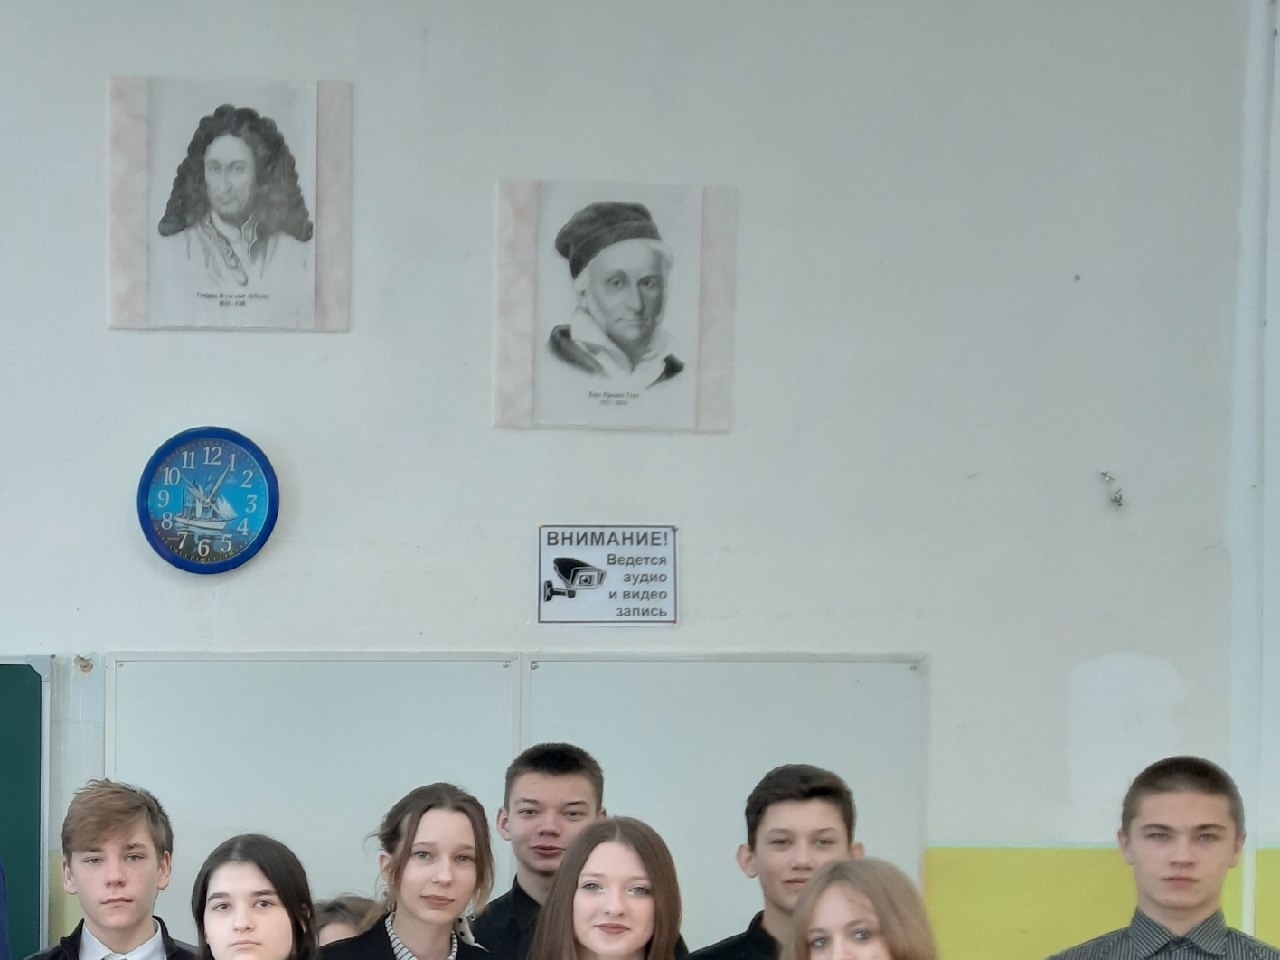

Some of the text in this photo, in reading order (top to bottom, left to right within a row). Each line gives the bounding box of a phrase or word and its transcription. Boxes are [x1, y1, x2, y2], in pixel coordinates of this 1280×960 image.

[181, 450, 195, 469] 11
[202, 446, 222, 466] 12
[228, 453, 236, 472] 1
[163, 467, 180, 486] 10
[241, 470, 253, 487] 2
[159, 490, 169, 507] 9
[245, 494, 257, 514] 3
[162, 513, 172, 529] 8
[237, 517, 249, 536] 4
[177, 531, 188, 550] 7
[197, 538, 210, 557] 6
[220, 533, 233, 552] 5
[546, 530, 669, 547] ВНИМАНИЕ!
[606, 553, 667, 568] Ведется
[623, 572, 668, 585] аудио
[608, 590, 668, 601] и видео
[615, 606, 668, 617] запись
